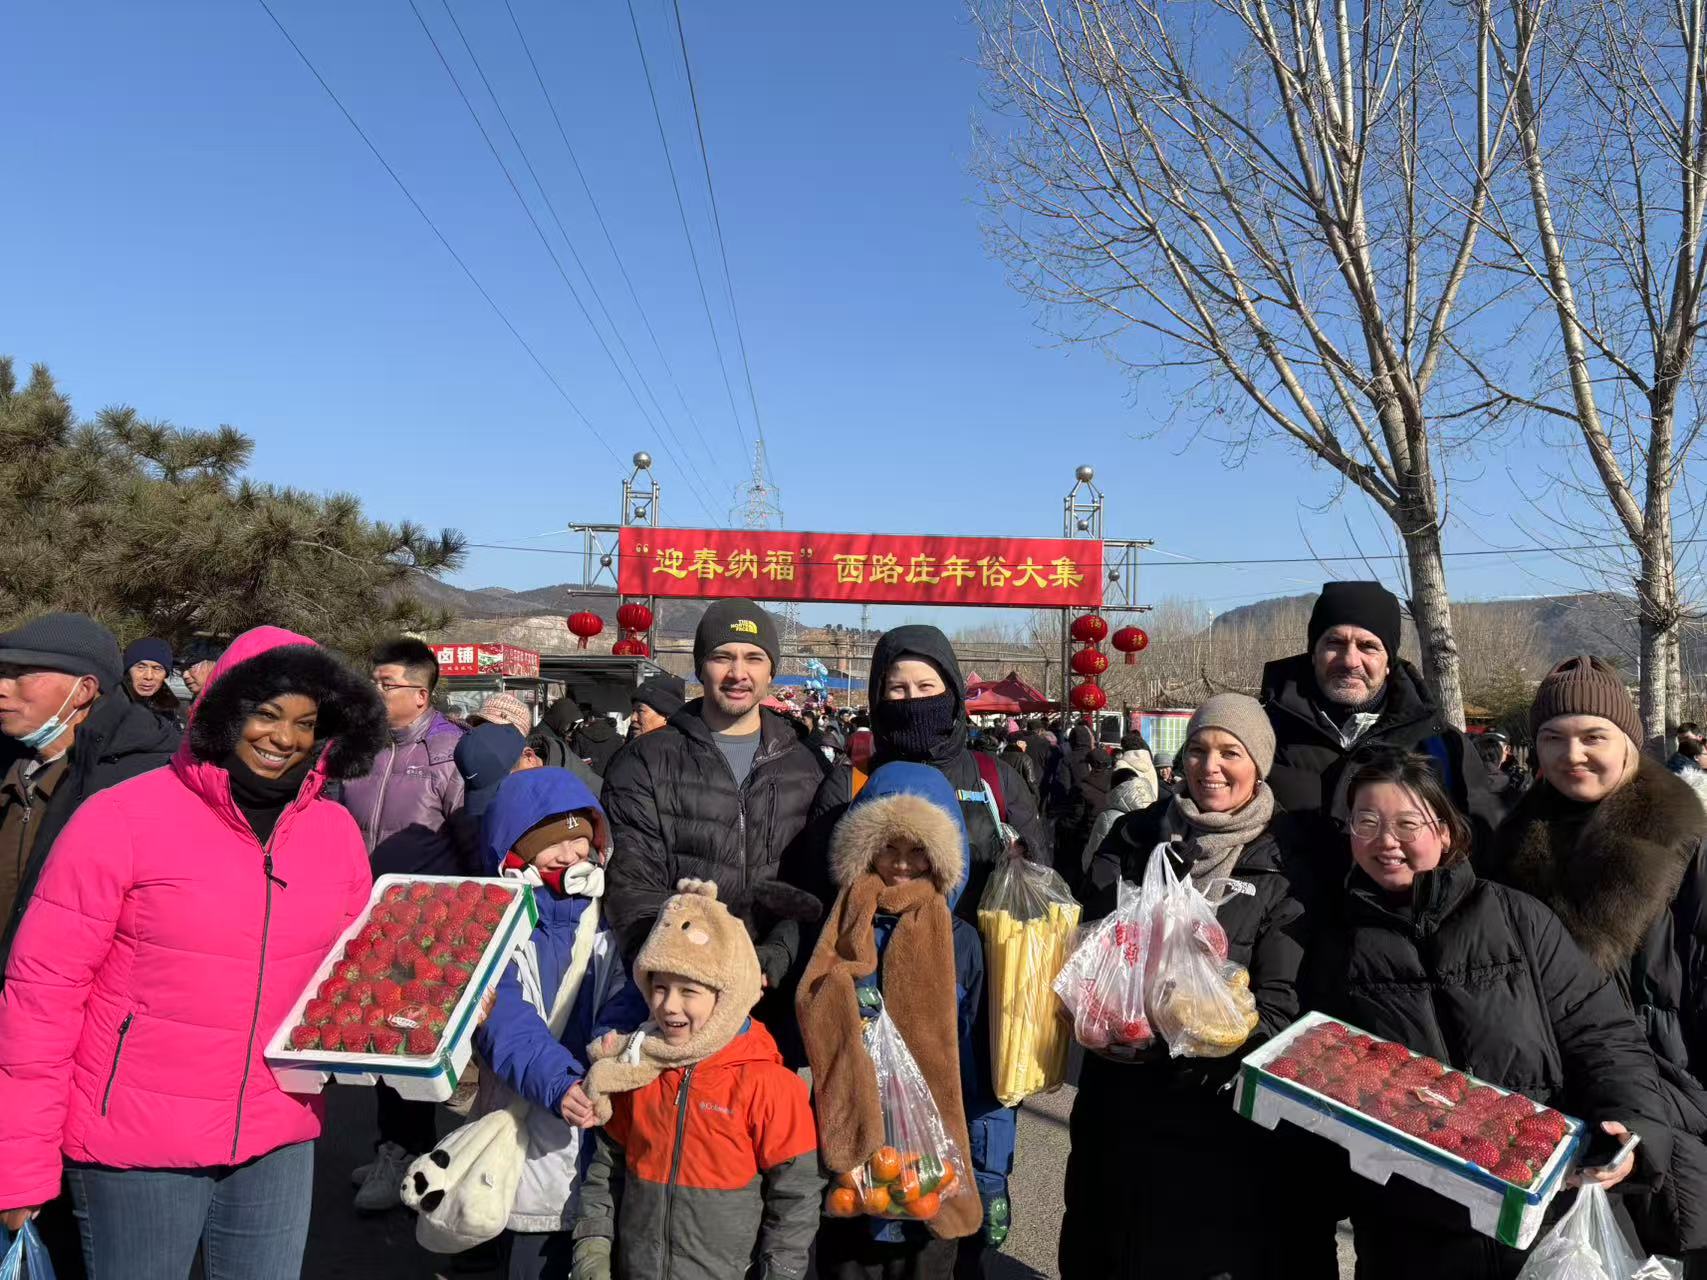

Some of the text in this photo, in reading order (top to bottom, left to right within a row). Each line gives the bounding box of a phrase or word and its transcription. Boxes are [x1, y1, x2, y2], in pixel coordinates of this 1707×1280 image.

[636, 543, 1085, 588] “迎春纳福” 西路庄年俗大集
[428, 646, 474, 664] 卤铺
[705, 1102, 735, 1114] Colu
